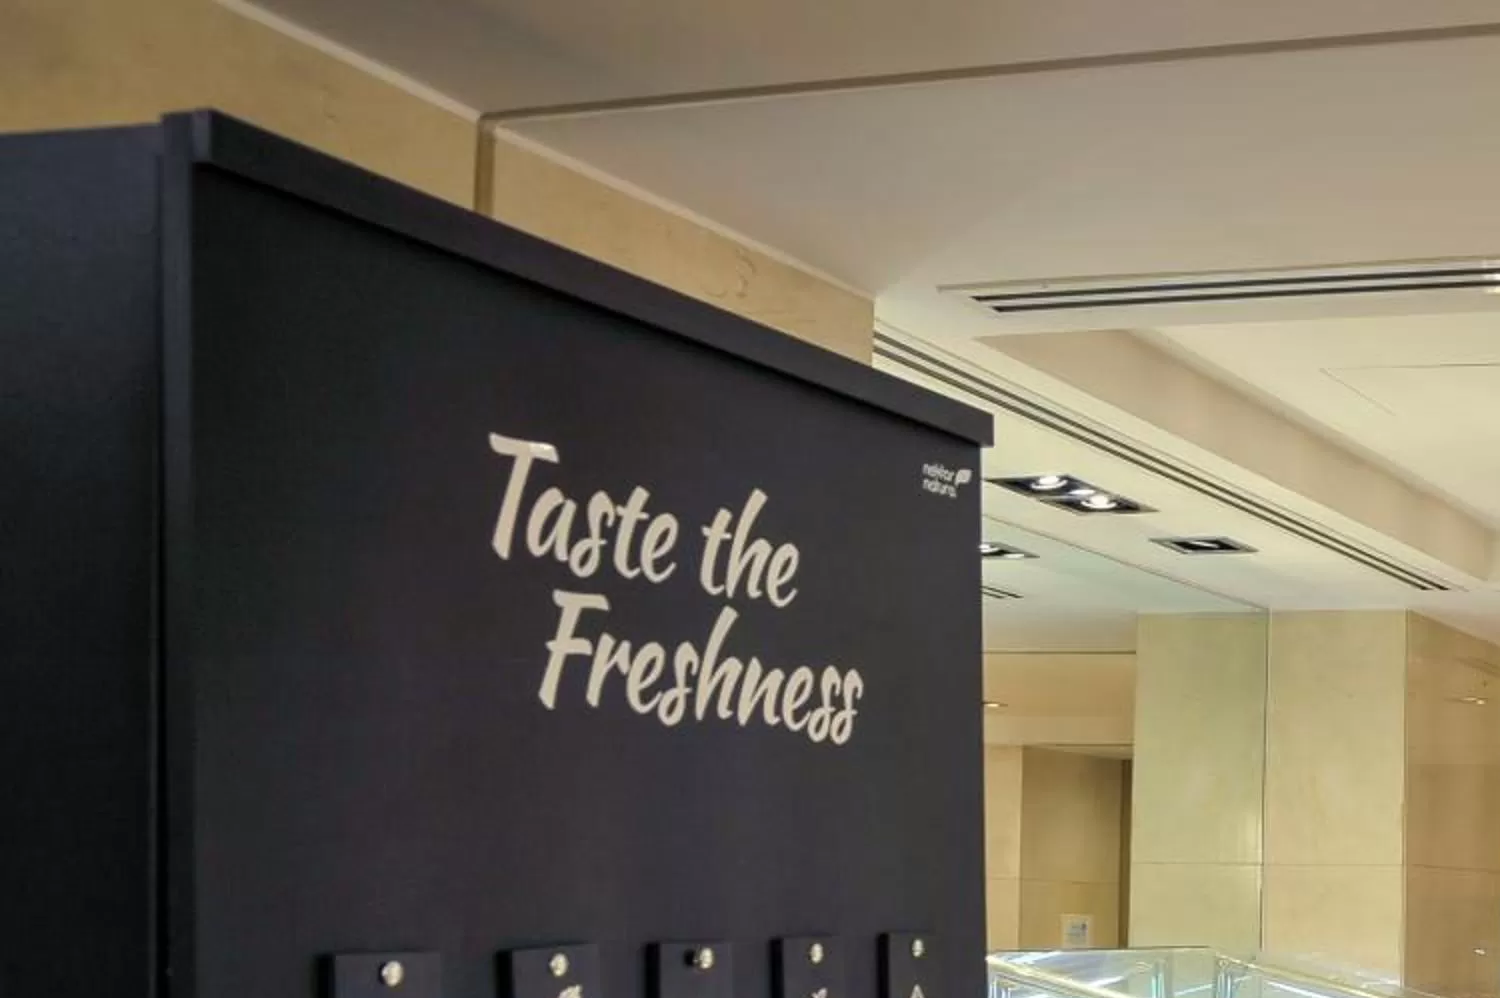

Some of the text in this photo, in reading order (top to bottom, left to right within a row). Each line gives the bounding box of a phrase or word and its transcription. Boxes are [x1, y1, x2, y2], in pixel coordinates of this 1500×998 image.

[489, 432, 800, 608] Taste the
[538, 589, 864, 744] Freshness
